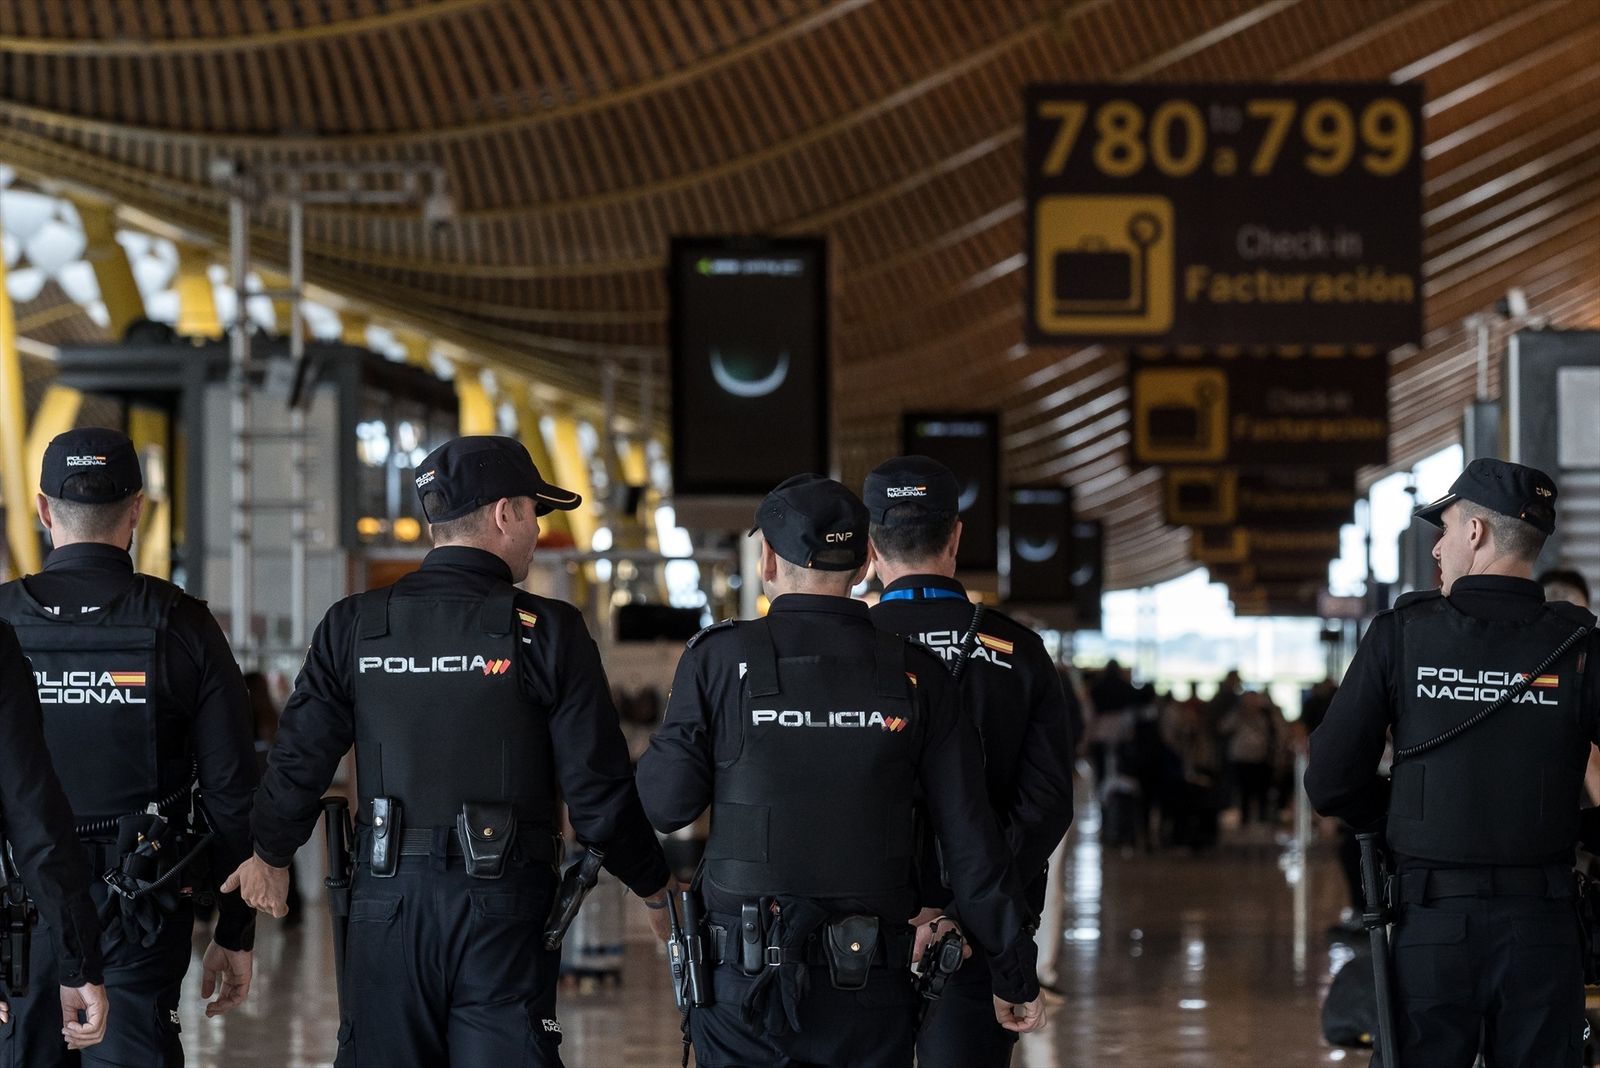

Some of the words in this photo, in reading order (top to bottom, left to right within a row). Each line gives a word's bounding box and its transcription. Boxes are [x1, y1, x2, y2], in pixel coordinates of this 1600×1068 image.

[1037, 99, 1208, 178] 780
[1246, 98, 1415, 178] 799
[1184, 264, 1415, 304] Facturación
[825, 532, 853, 543] CNP
[919, 630, 982, 645] ICIA
[359, 654, 487, 674] POLICIA
[33, 671, 116, 687] LICIA
[38, 688, 147, 704] CIONAL
[752, 709, 887, 728] POLICIA
